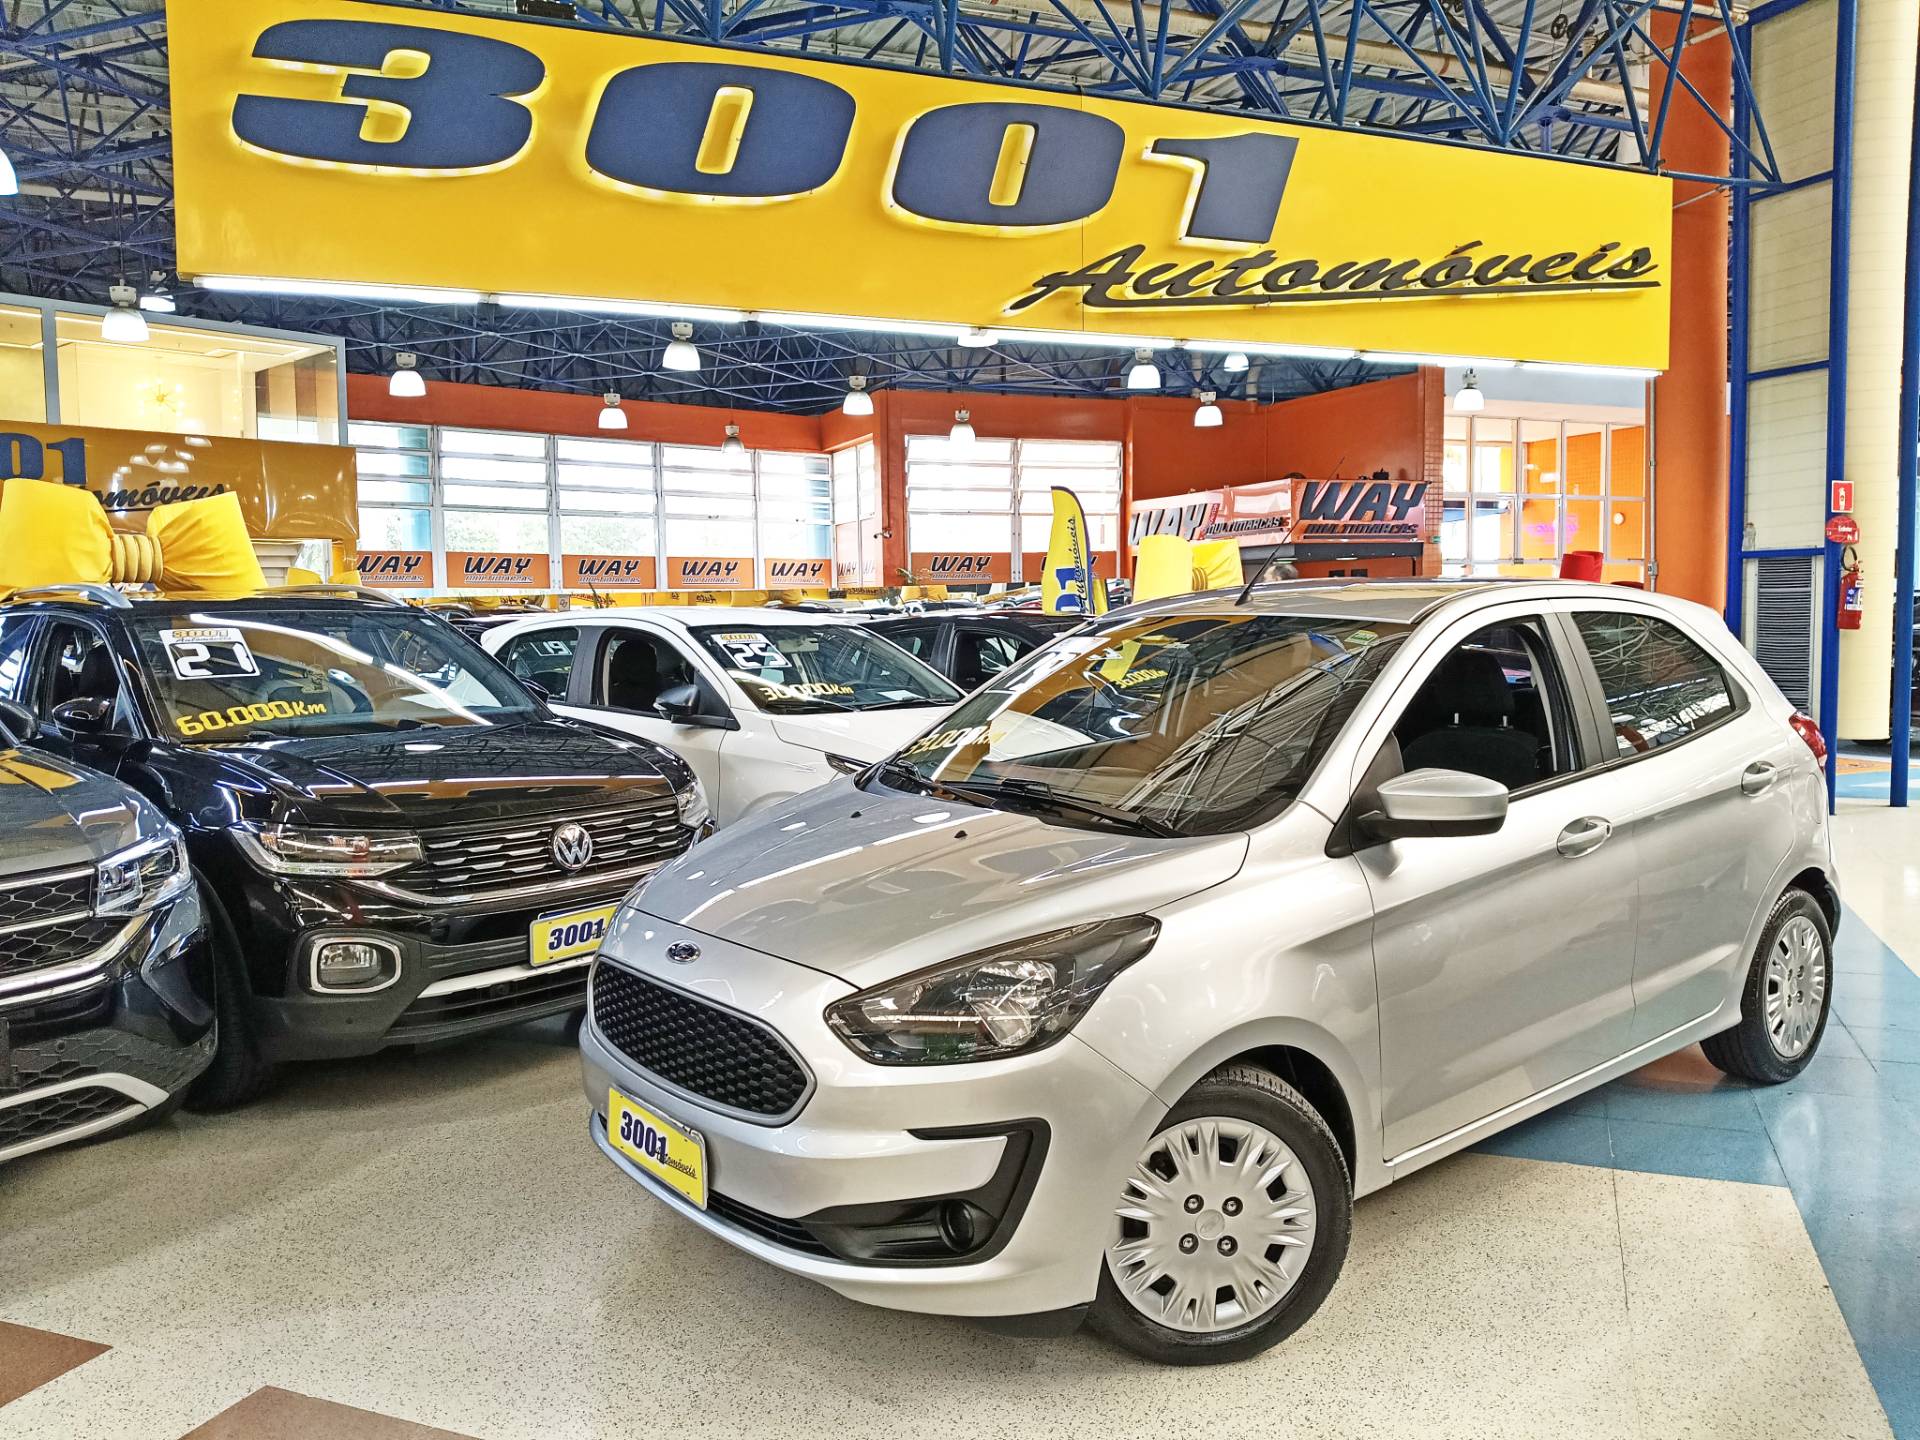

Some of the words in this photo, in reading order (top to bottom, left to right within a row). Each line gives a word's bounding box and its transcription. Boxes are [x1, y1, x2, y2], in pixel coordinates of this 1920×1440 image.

[230, 18, 1298, 243] 3001
[1003, 240, 1661, 312] Automóveis
[1299, 481, 1430, 521] WAY
[1128, 502, 1209, 545] WAY
[1305, 523, 1419, 535] MULTIMARCAS
[463, 556, 533, 574] WAY
[577, 559, 641, 576] WAY
[681, 560, 740, 577] WAY
[771, 562, 824, 577] WAY
[931, 556, 992, 573] WAY
[174, 642, 255, 676] 21
[727, 642, 788, 667] 25
[548, 917, 605, 951] 3001
[620, 1110, 668, 1165] 3001
